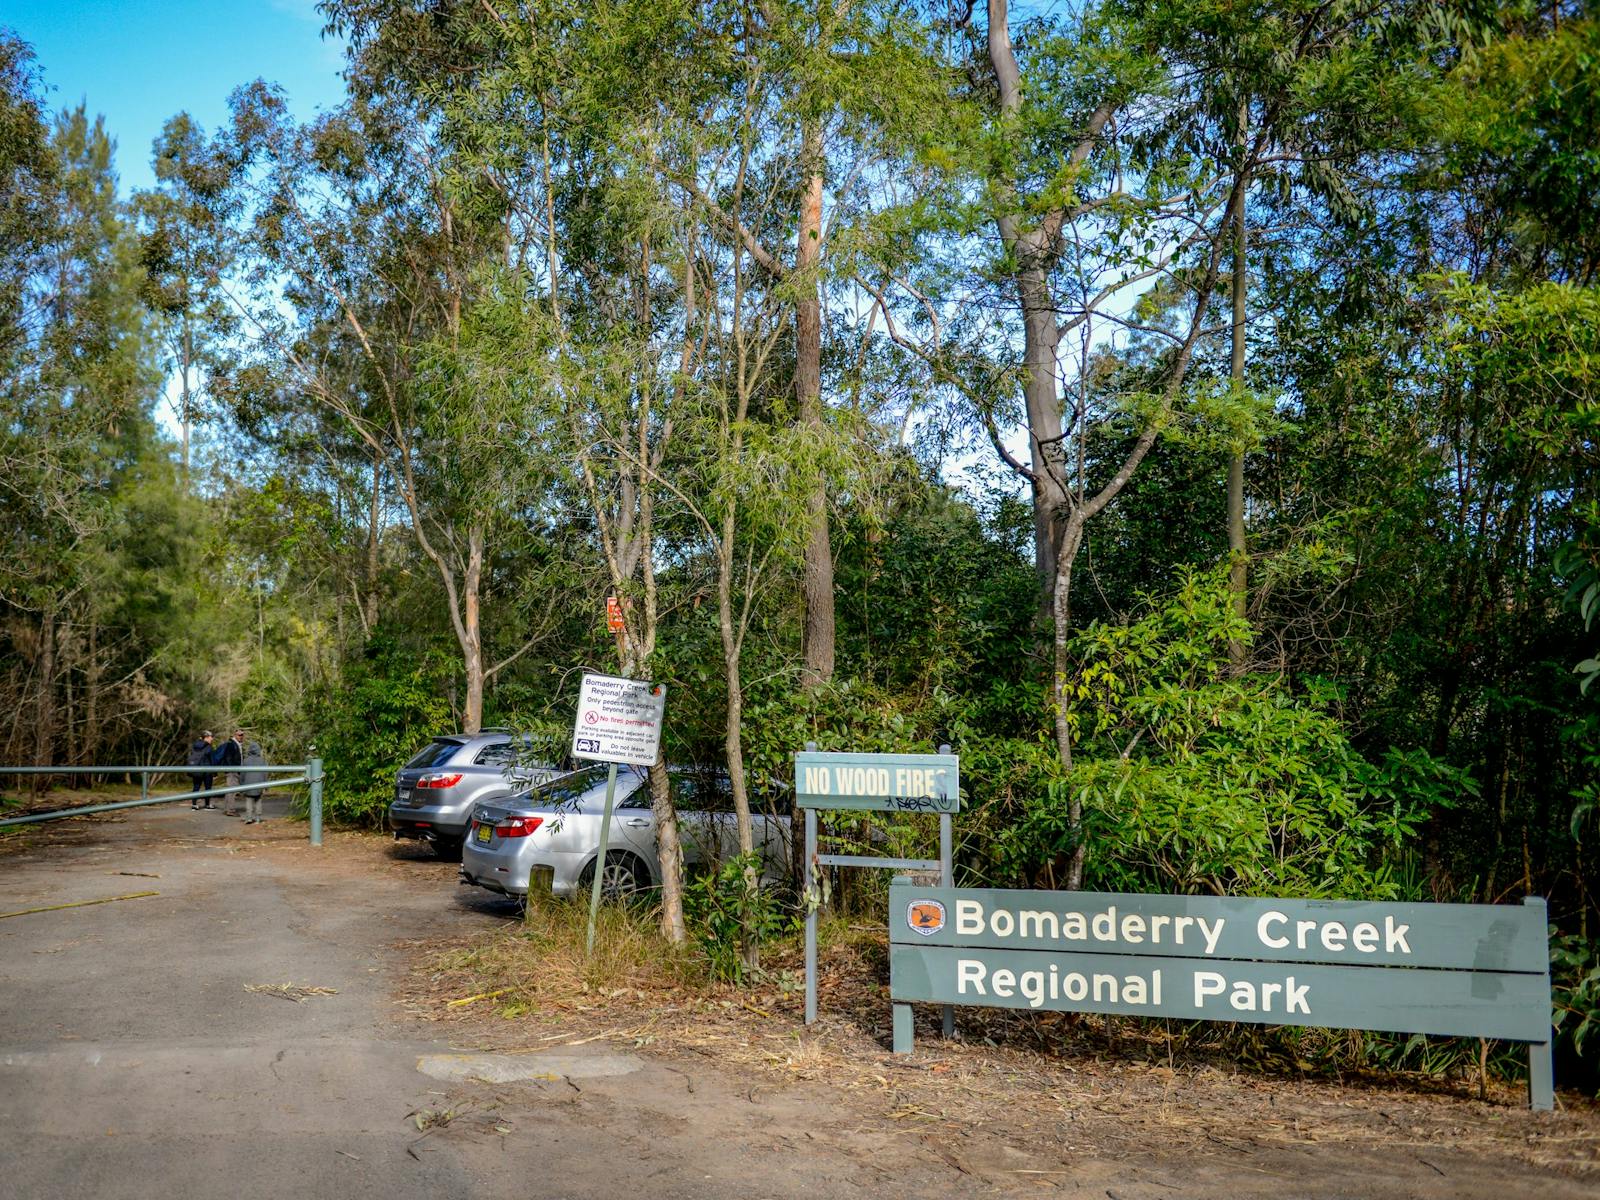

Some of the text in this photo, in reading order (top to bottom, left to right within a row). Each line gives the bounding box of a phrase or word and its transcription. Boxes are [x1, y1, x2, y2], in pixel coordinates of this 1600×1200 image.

[586, 679, 646, 692] Bomaderry Creek
[592, 688, 620, 697] Regional
[625, 719, 655, 727] permitted
[635, 752, 654, 760] vehicle
[805, 767, 830, 795] NO
[836, 768, 889, 796] WOOD
[955, 899, 1225, 954] Bomaderry
[1257, 910, 1412, 954] Creek
[957, 959, 1312, 1015] Regional Park
